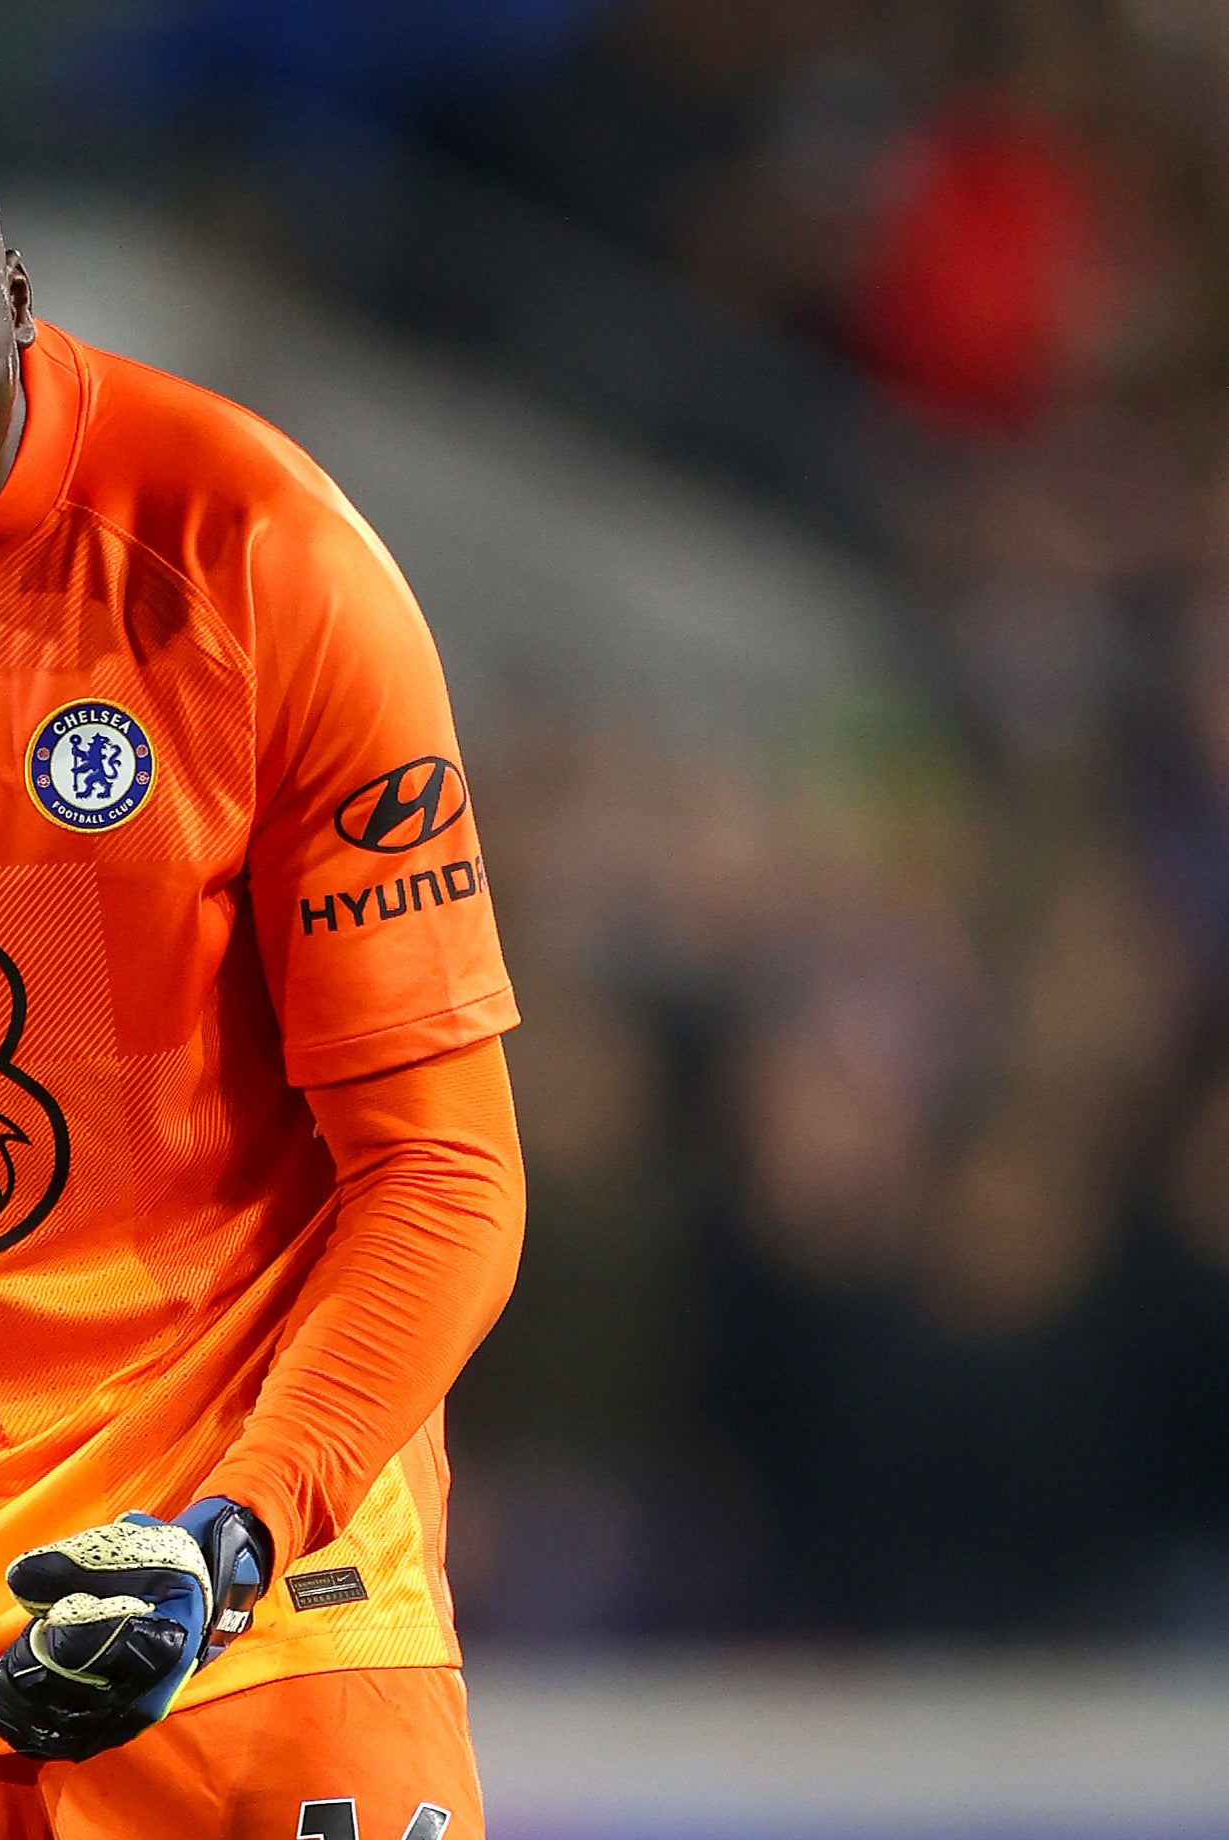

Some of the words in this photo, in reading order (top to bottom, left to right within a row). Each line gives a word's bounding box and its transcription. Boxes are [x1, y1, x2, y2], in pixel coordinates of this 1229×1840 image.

[53, 709, 131, 735] CHELSEA
[51, 800, 105, 824] FOOTBALL
[108, 797, 135, 820] CLUB
